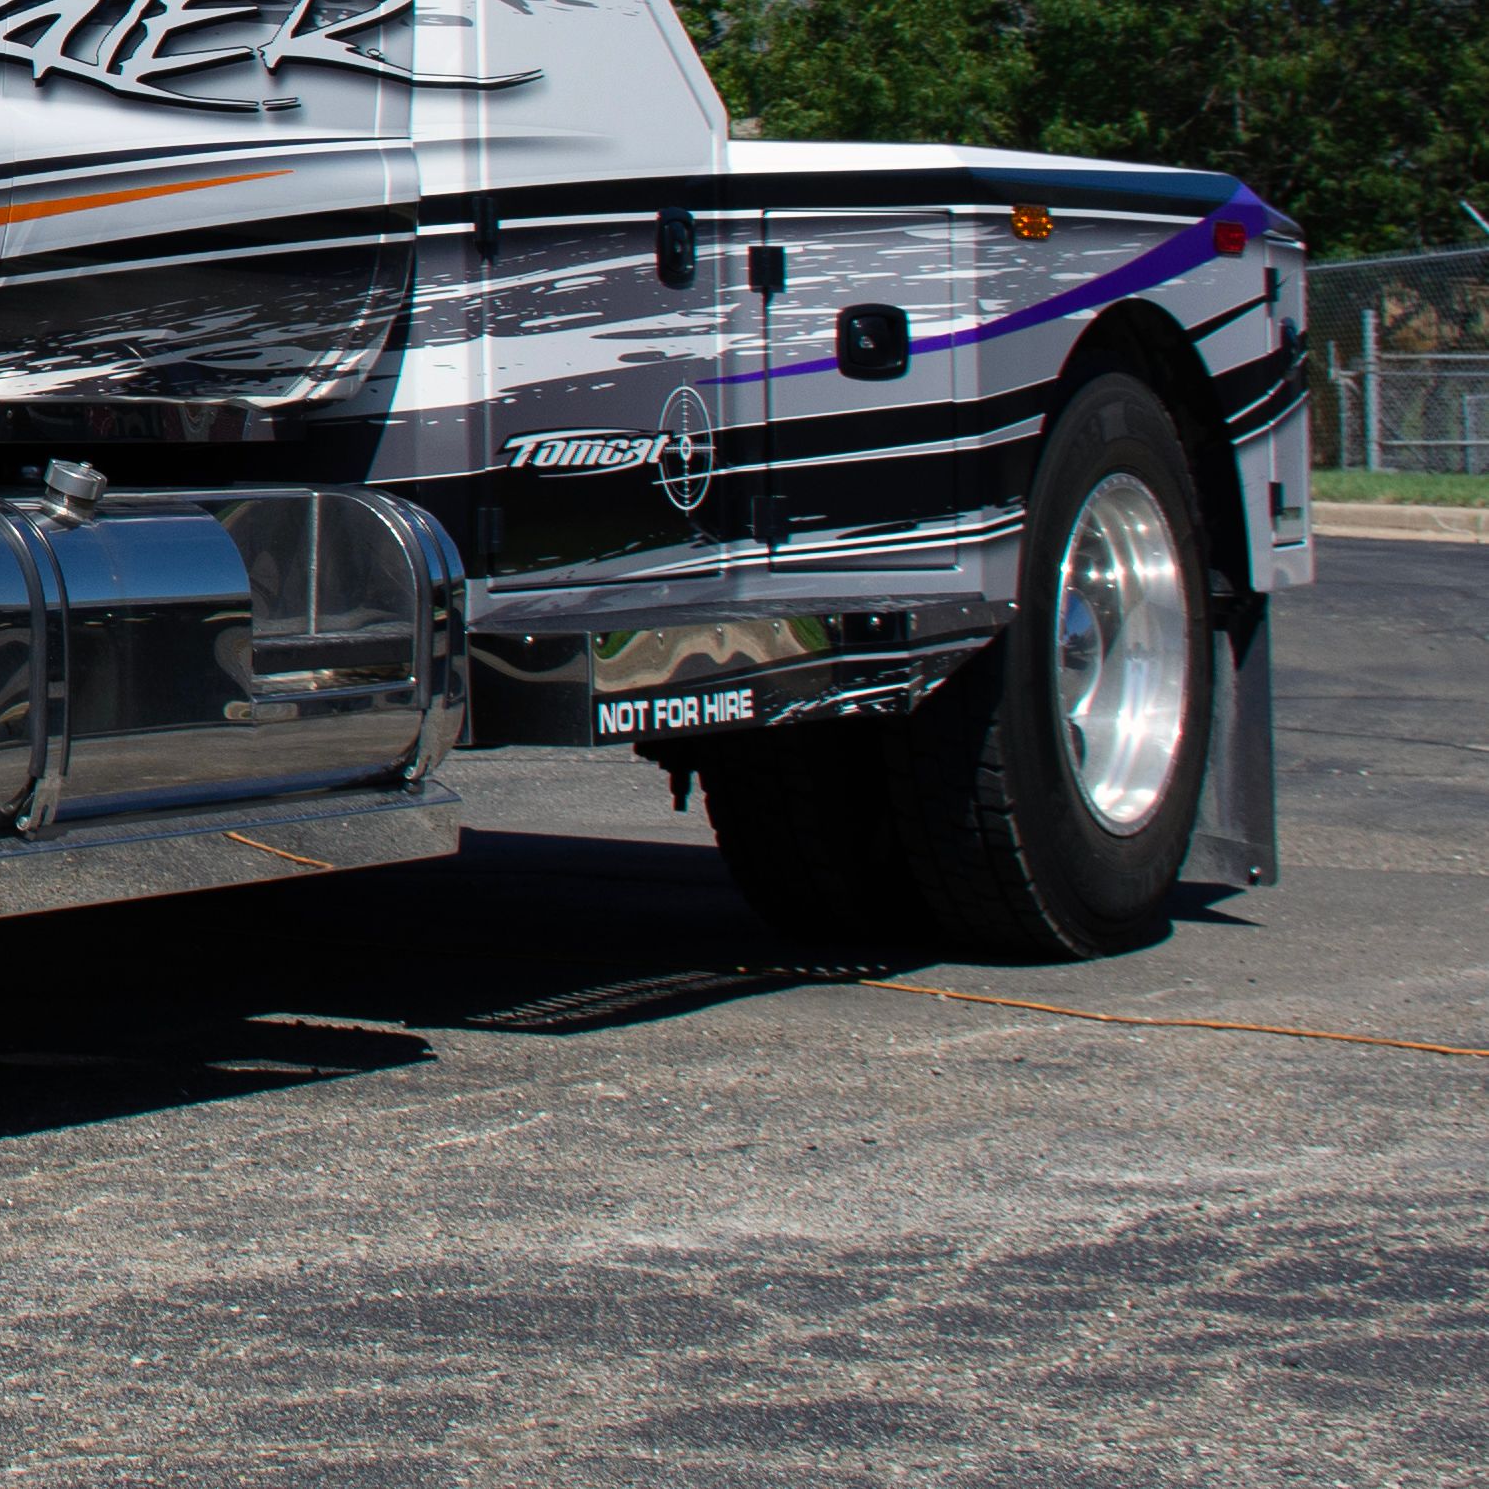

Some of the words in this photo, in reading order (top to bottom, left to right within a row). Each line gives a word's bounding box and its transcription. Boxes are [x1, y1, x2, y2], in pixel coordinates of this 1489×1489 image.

[505, 428, 671, 473] Tomcat
[597, 700, 649, 735] NOT
[653, 696, 700, 730] FOR
[702, 688, 754, 724] HIRE
